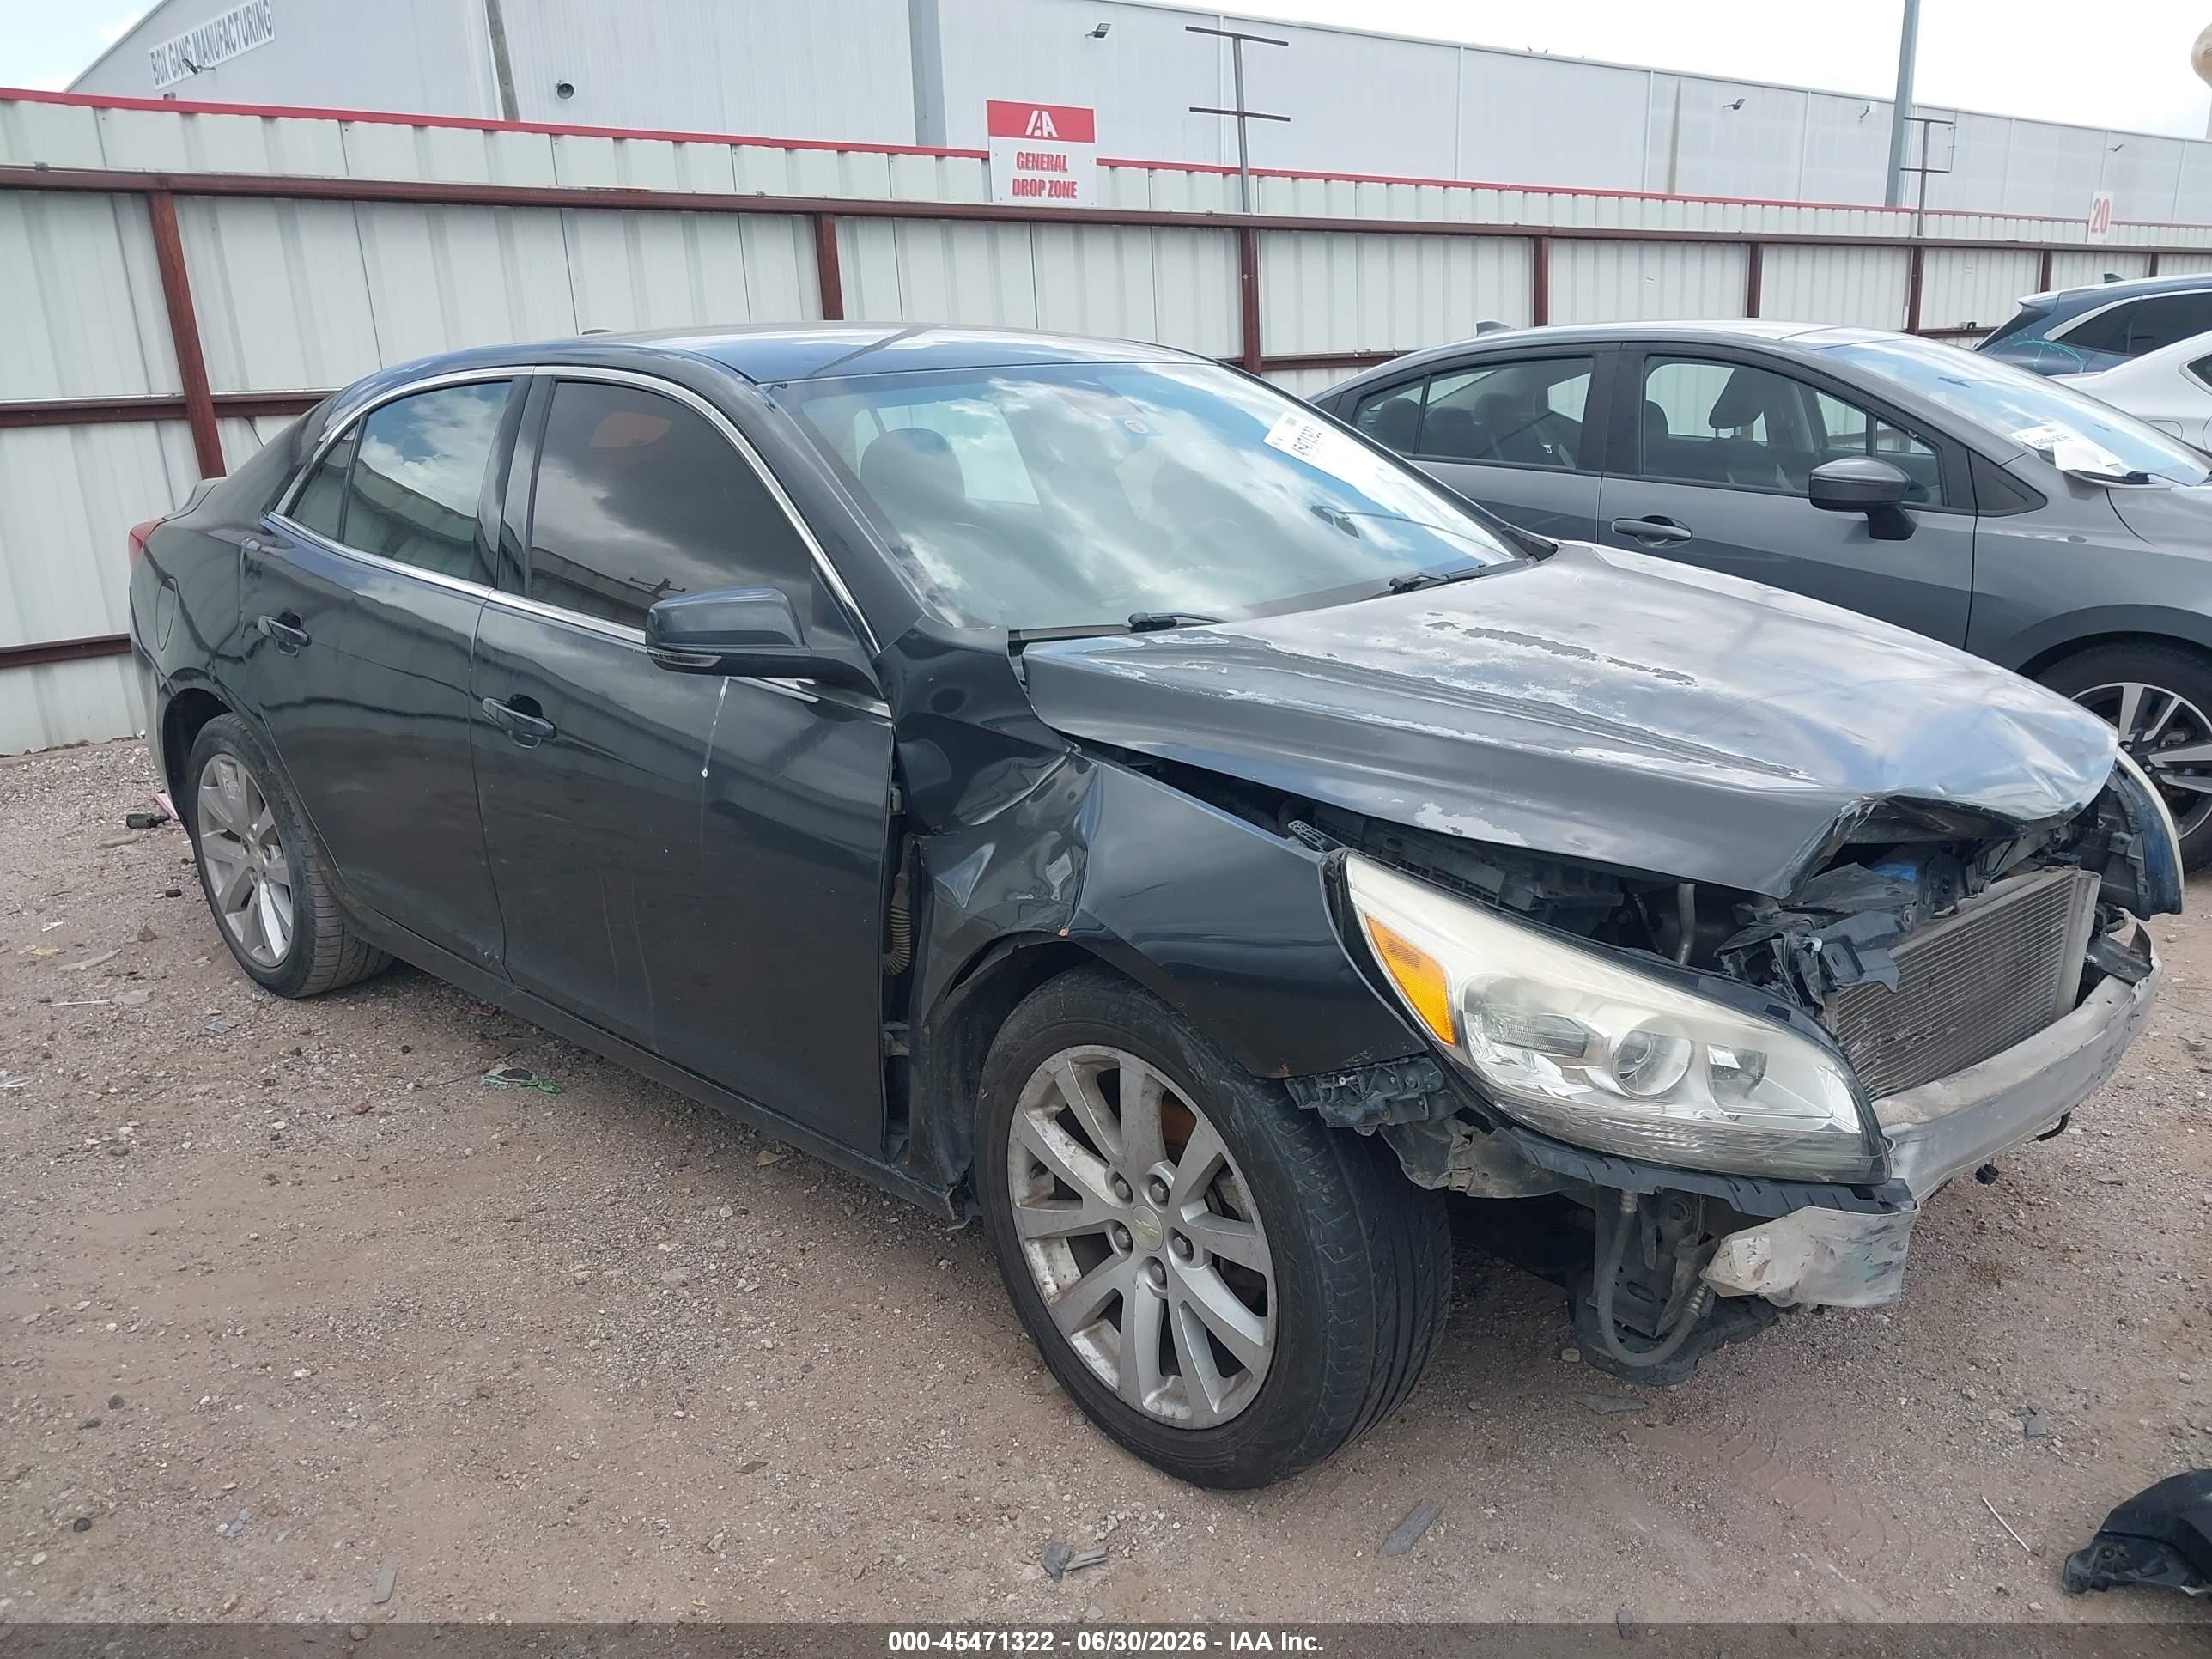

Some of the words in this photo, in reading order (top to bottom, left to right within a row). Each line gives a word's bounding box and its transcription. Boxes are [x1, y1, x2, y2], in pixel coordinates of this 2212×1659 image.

[150, 46, 171, 86] BOX
[168, 35, 193, 79] GANG
[192, 0, 273, 65] MANUFACTURING
[1016, 151, 1069, 173] GENERAL
[1012, 178, 1047, 198] DROP
[1047, 179, 1079, 200] ZONE
[2091, 198, 2110, 234] 20
